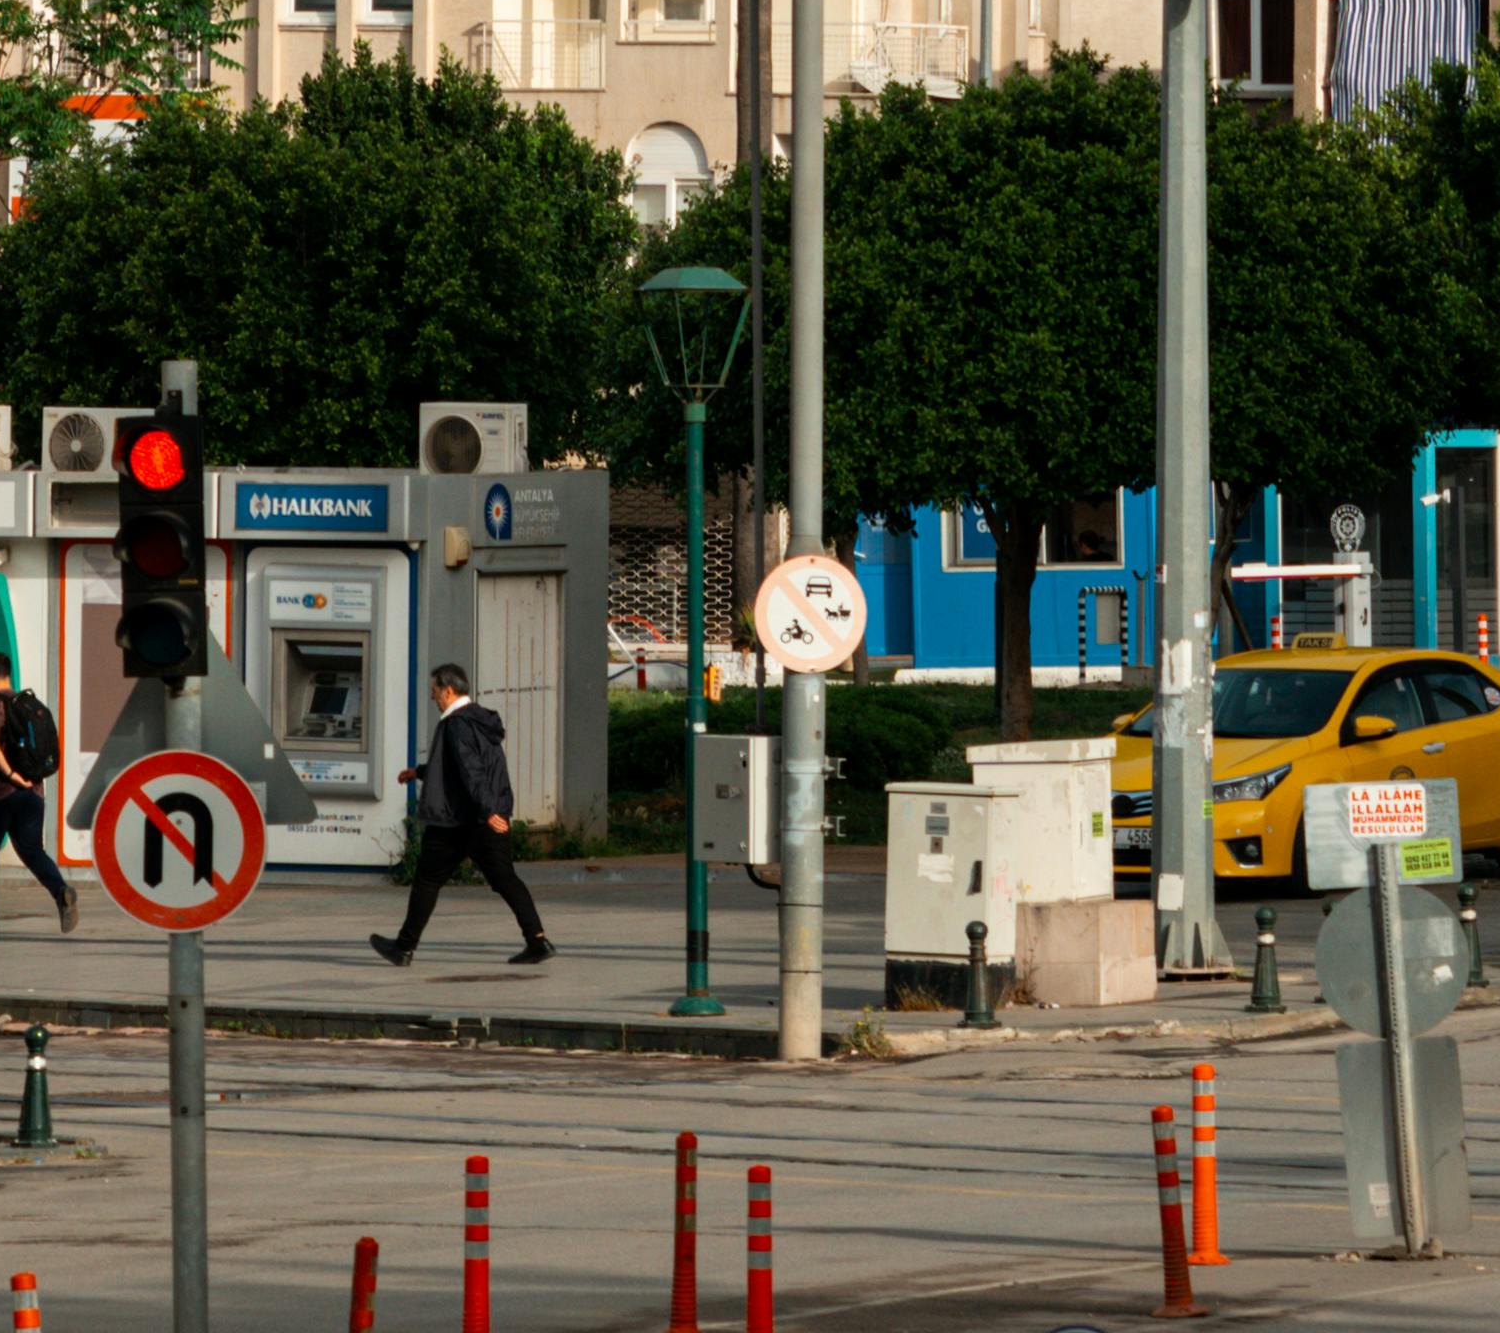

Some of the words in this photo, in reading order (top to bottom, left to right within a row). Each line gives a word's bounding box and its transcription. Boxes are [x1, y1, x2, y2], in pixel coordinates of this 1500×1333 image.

[514, 488, 554, 502] ANTALYA
[272, 498, 372, 517] HALKBANK
[277, 596, 300, 605] BANK
[1352, 815, 1423, 824] MUHAMMEDUN
[1352, 825, 1424, 834] RESULULLAH
